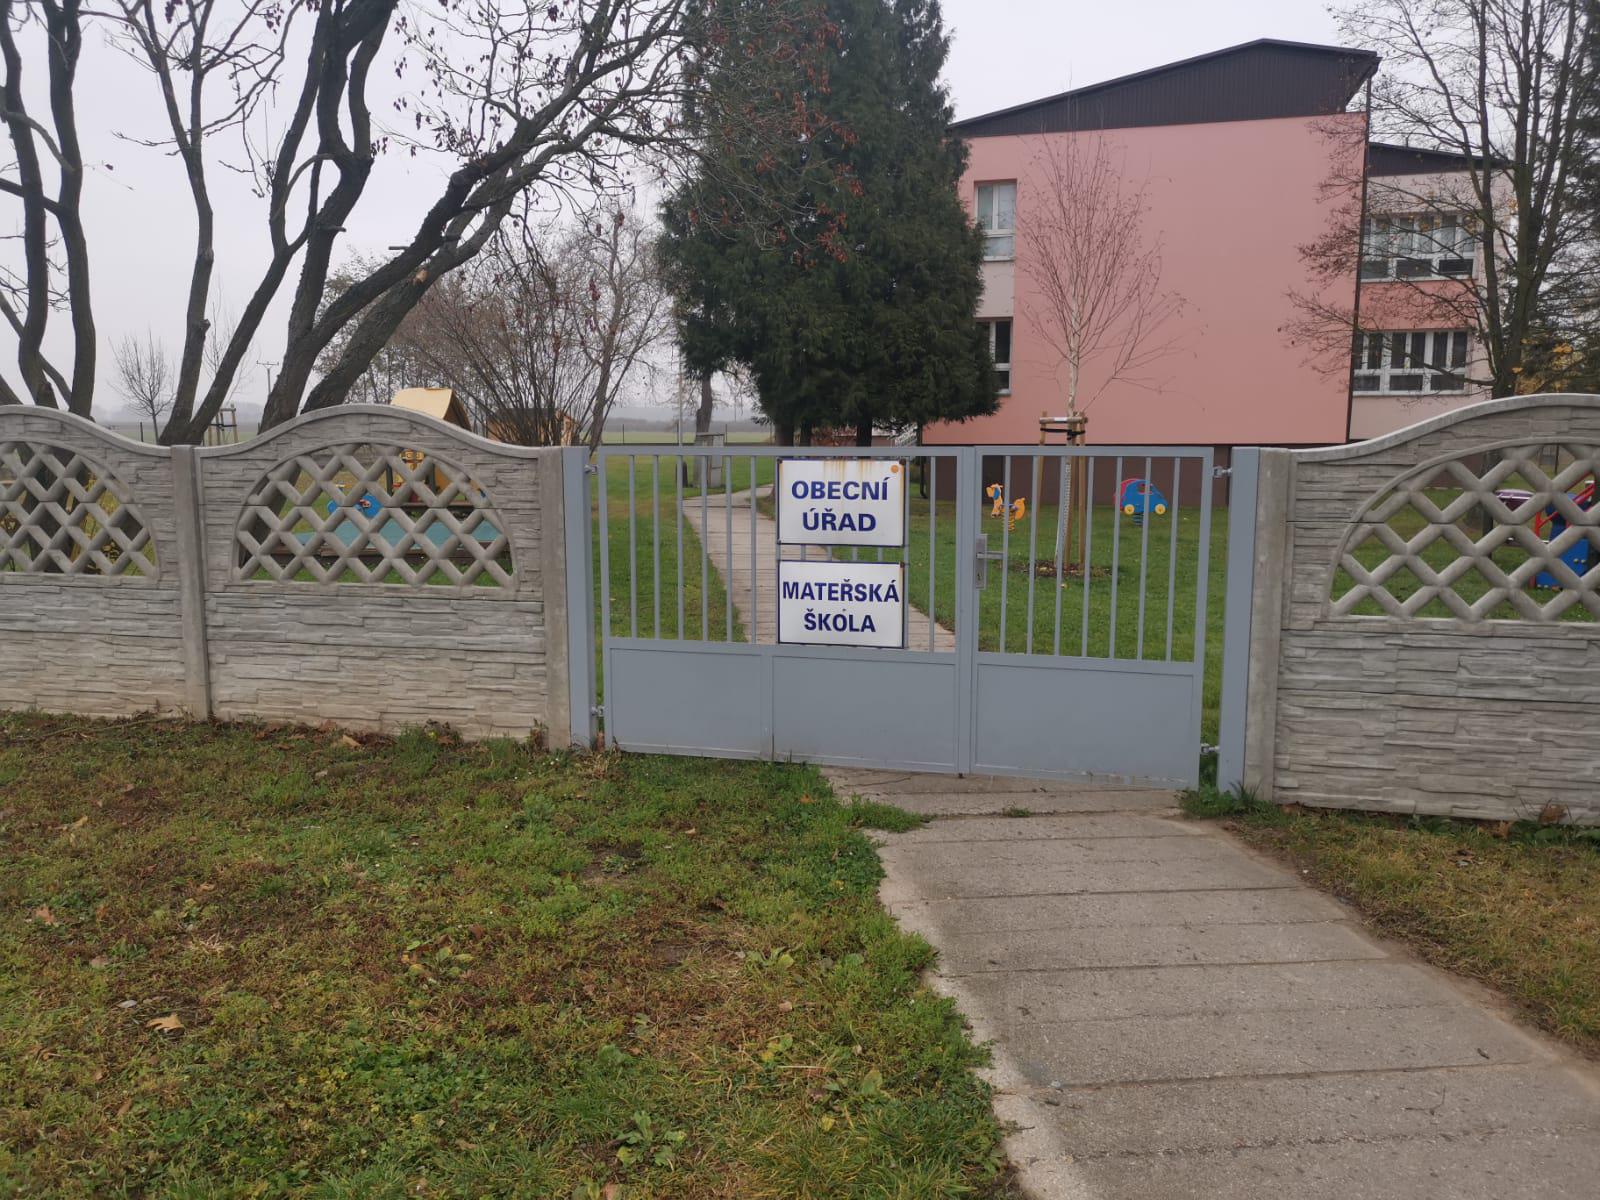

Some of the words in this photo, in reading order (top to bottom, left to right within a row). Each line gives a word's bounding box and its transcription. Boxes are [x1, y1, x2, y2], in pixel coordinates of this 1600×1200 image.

[791, 476, 890, 501] OBECNÍ
[802, 507, 877, 532] ÚŘAD
[782, 578, 900, 603] MATEŘSKÁ
[803, 608, 876, 633] ŠKOLA
